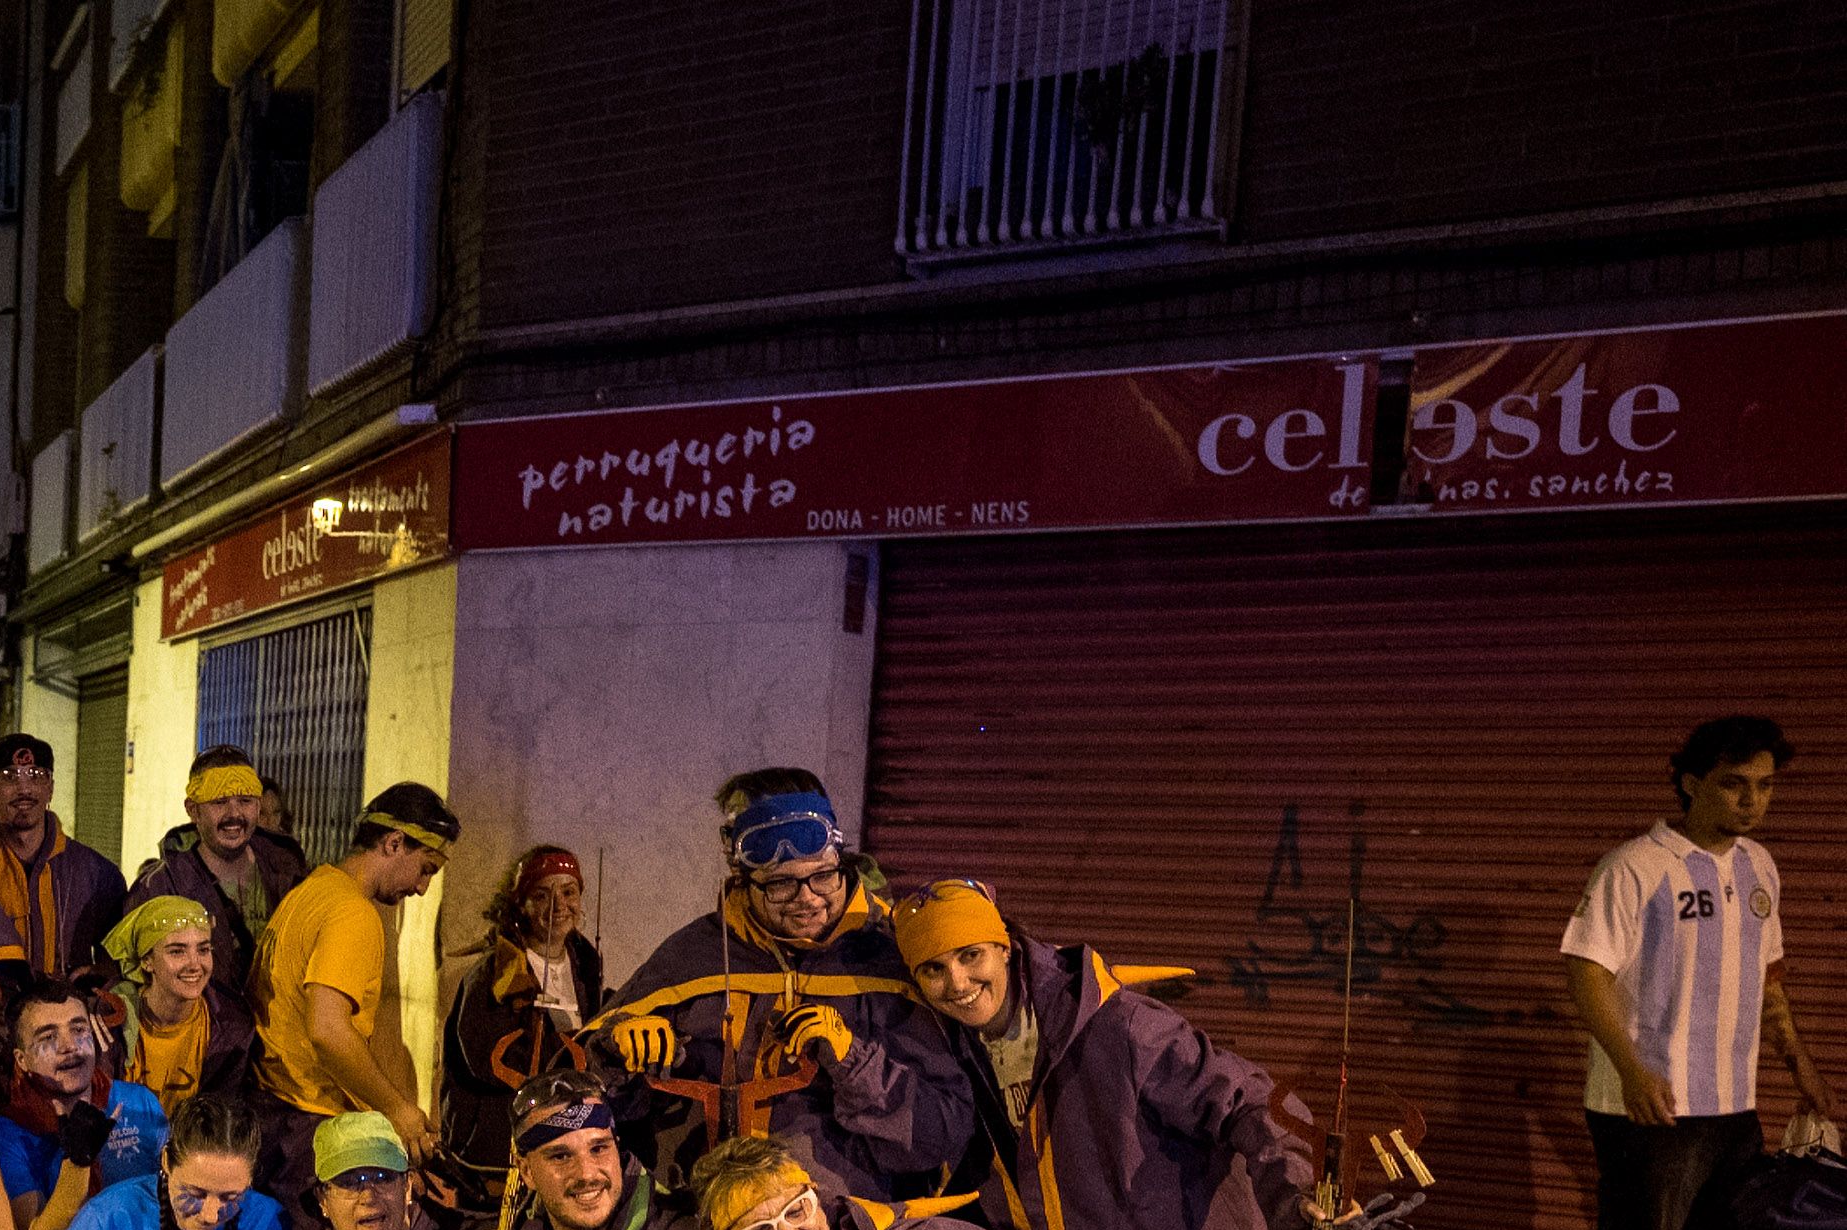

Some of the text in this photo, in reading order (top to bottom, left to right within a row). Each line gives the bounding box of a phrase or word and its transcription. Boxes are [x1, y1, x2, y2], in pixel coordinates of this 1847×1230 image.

[517, 404, 817, 510] perruqueria
[557, 470, 797, 538] naturista
[1329, 475, 1366, 507] de
[1529, 458, 1674, 498] sanchez
[806, 508, 864, 532] DONA
[885, 504, 947, 528] HOME
[970, 500, 1031, 525] NENS
[1677, 889, 1714, 920] 26
